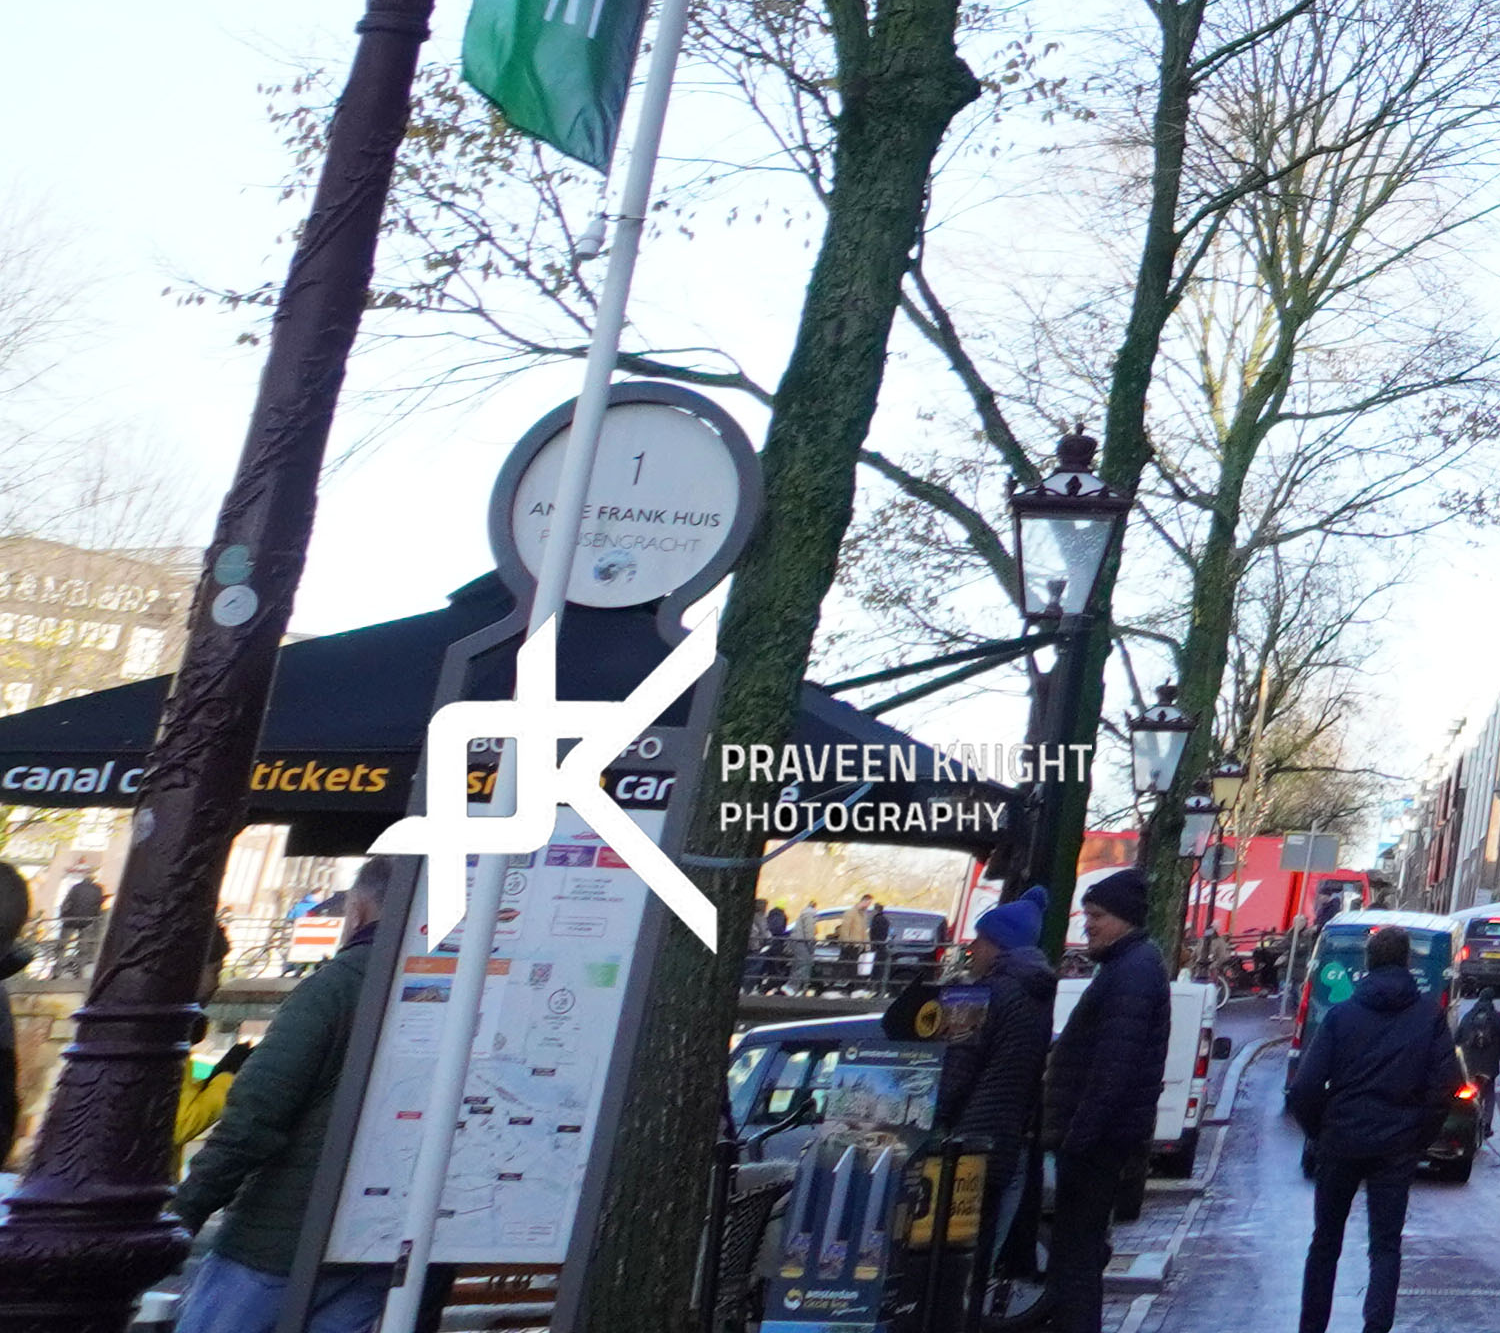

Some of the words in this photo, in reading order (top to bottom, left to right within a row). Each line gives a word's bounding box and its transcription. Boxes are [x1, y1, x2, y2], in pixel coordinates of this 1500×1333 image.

[631, 450, 647, 486] 1
[597, 506, 666, 525] FRANK
[671, 510, 721, 528] HUIS
[2, 760, 115, 794] canal
[250, 759, 389, 793] tickets
